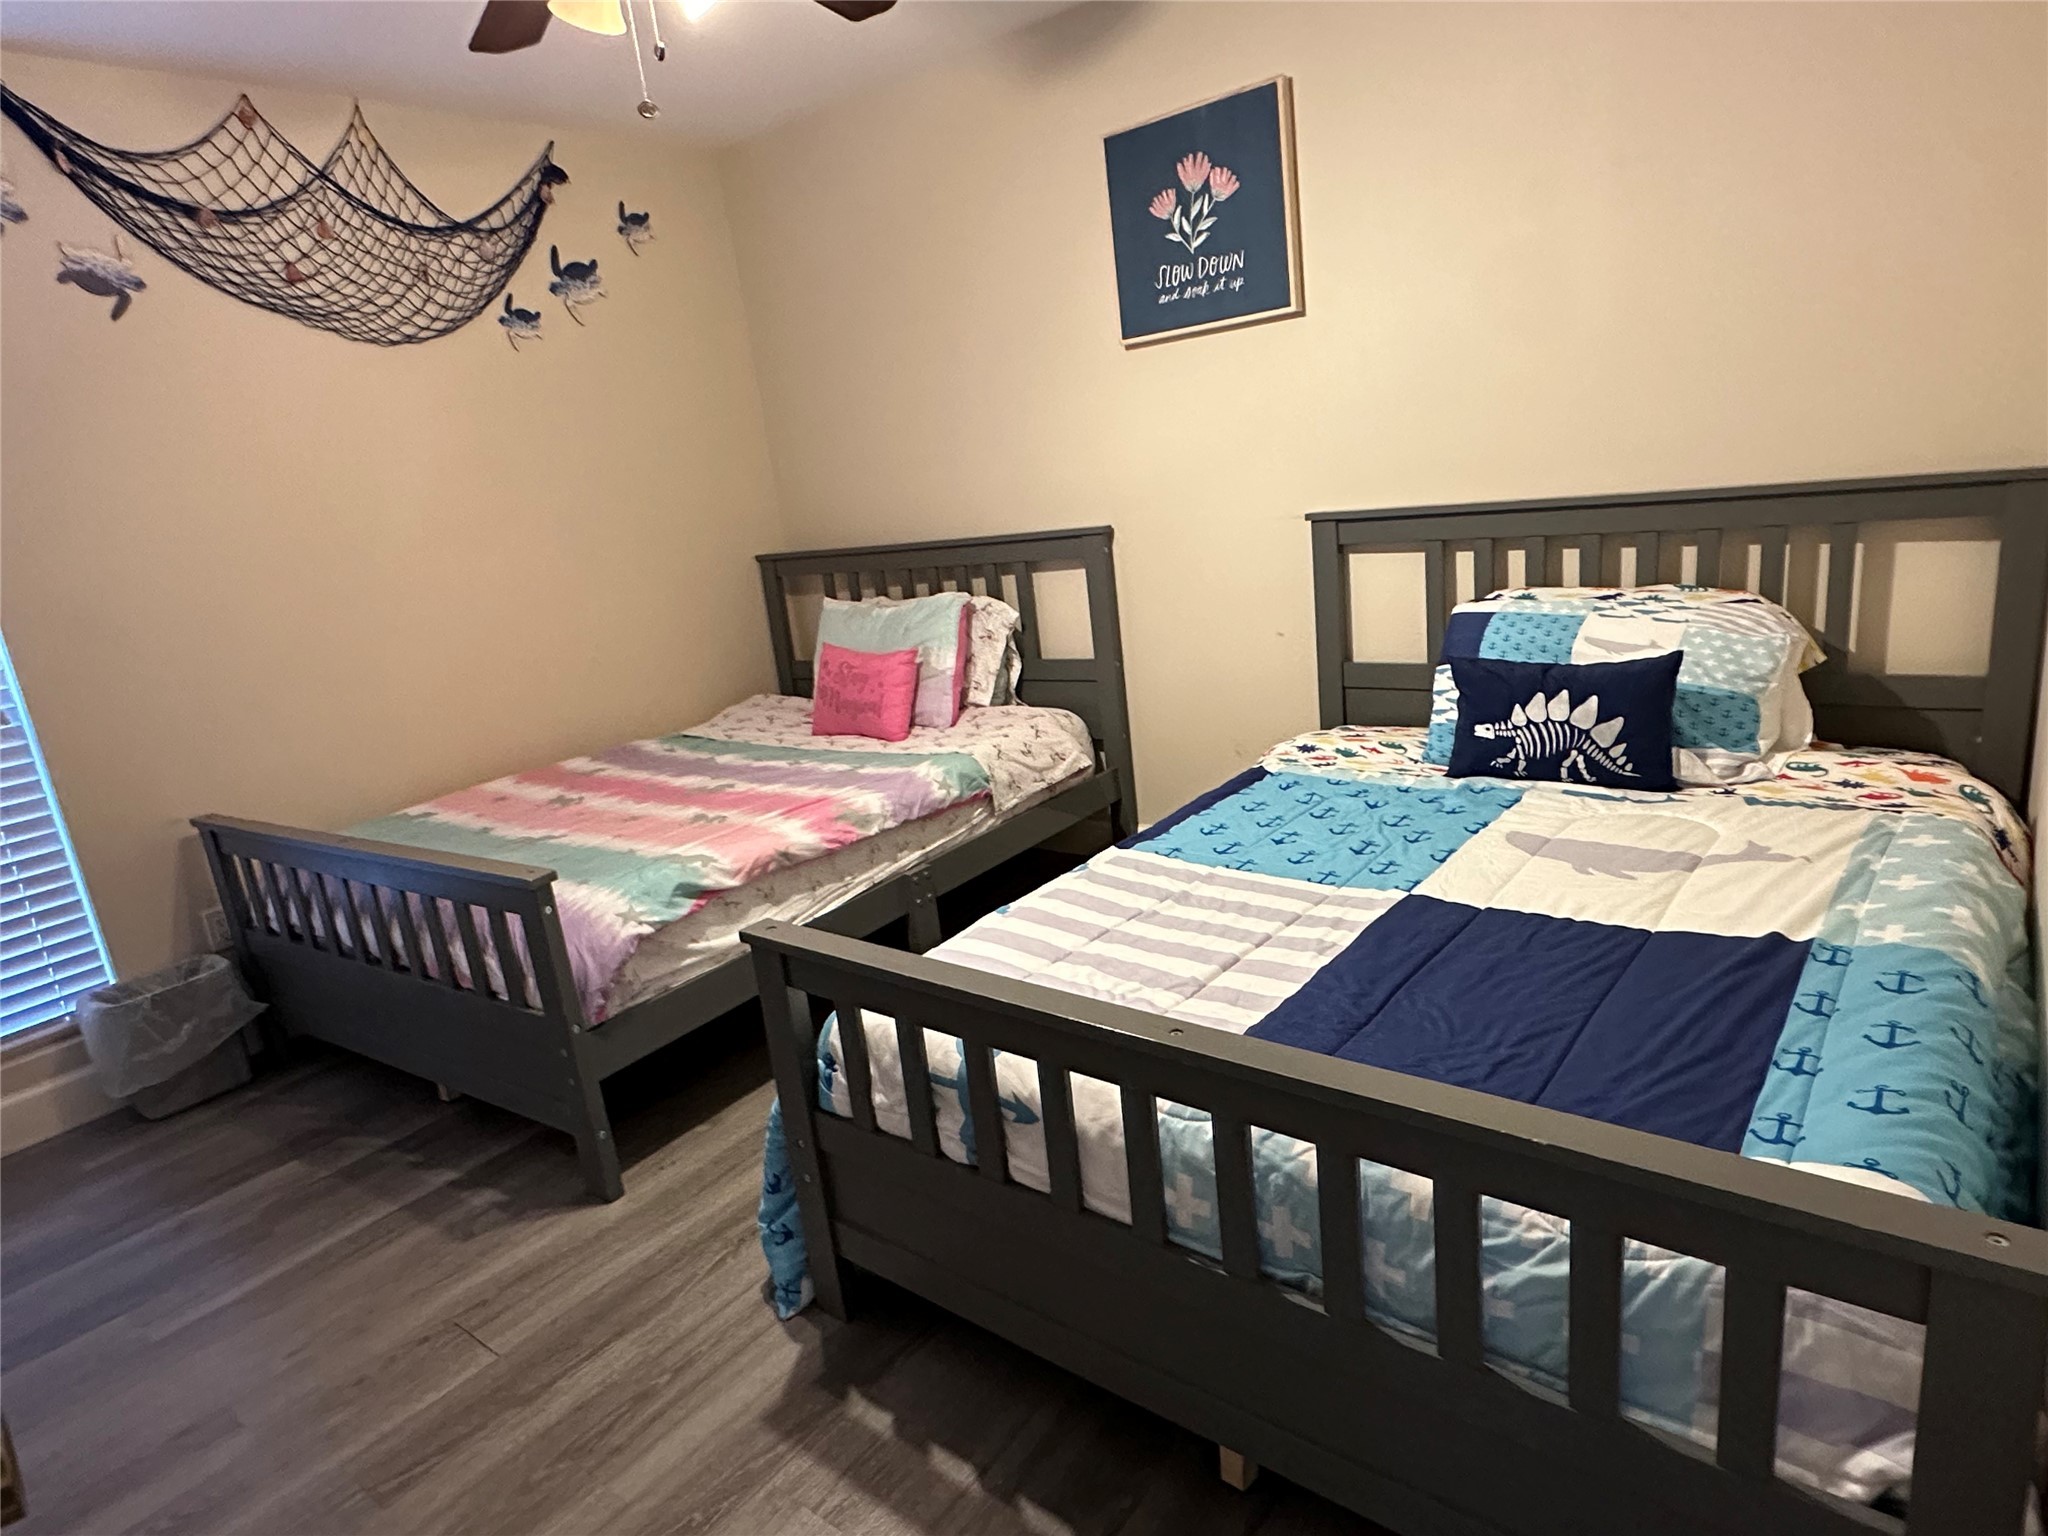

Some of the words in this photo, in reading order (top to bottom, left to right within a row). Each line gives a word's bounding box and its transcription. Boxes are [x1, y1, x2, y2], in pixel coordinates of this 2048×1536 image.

[1154, 262, 1194, 289] SLOW
[1198, 250, 1245, 279] DOWN
[1158, 288, 1181, 304] and
[1183, 280, 1211, 299] soak
[1212, 276, 1226, 293] it
[1229, 277, 1245, 292] up
